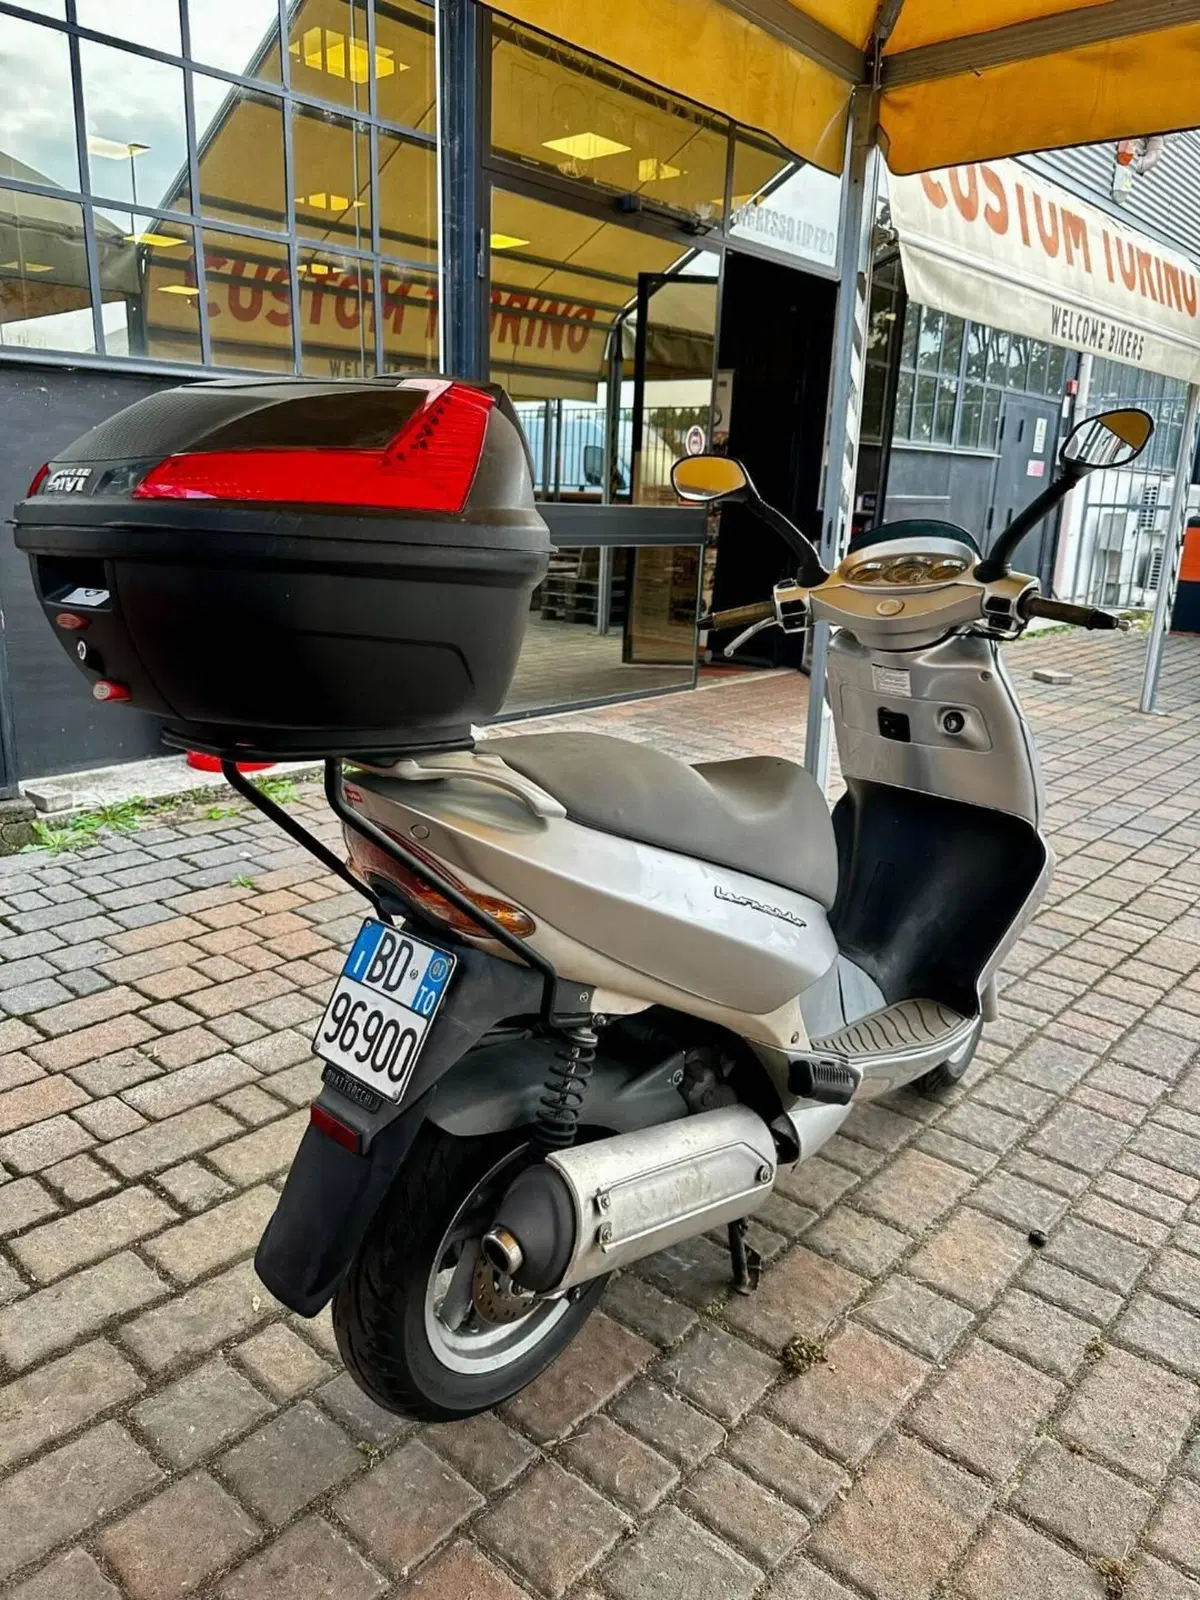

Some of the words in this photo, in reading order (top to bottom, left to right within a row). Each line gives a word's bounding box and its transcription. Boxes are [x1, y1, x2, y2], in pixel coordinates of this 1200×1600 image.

[1052, 304, 1106, 349] WELCOME
[1108, 325, 1144, 361] BIKERS
[366, 932, 414, 992] BD
[414, 985, 436, 1015] TO
[324, 992, 417, 1082] 96900
